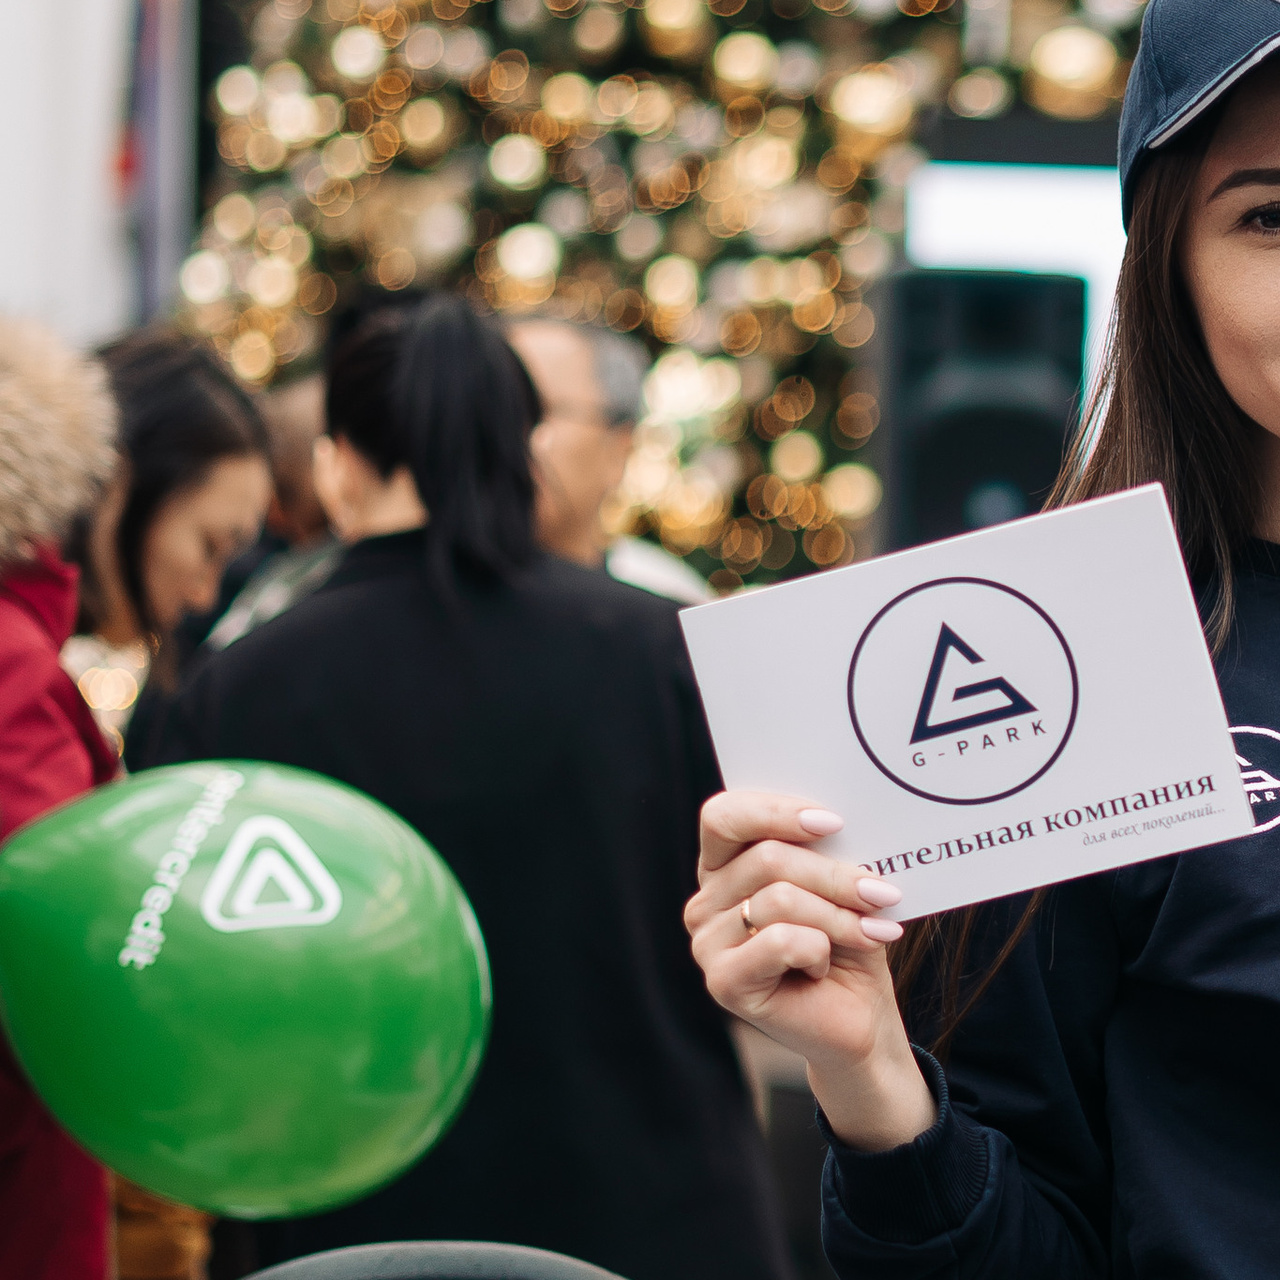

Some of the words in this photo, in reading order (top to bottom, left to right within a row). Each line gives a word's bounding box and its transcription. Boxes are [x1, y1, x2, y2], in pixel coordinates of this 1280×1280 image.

[911, 719, 1047, 767] G-PARK
[1042, 774, 1218, 834] компания
[1082, 832, 1107, 847] для
[1111, 823, 1142, 840] всех
